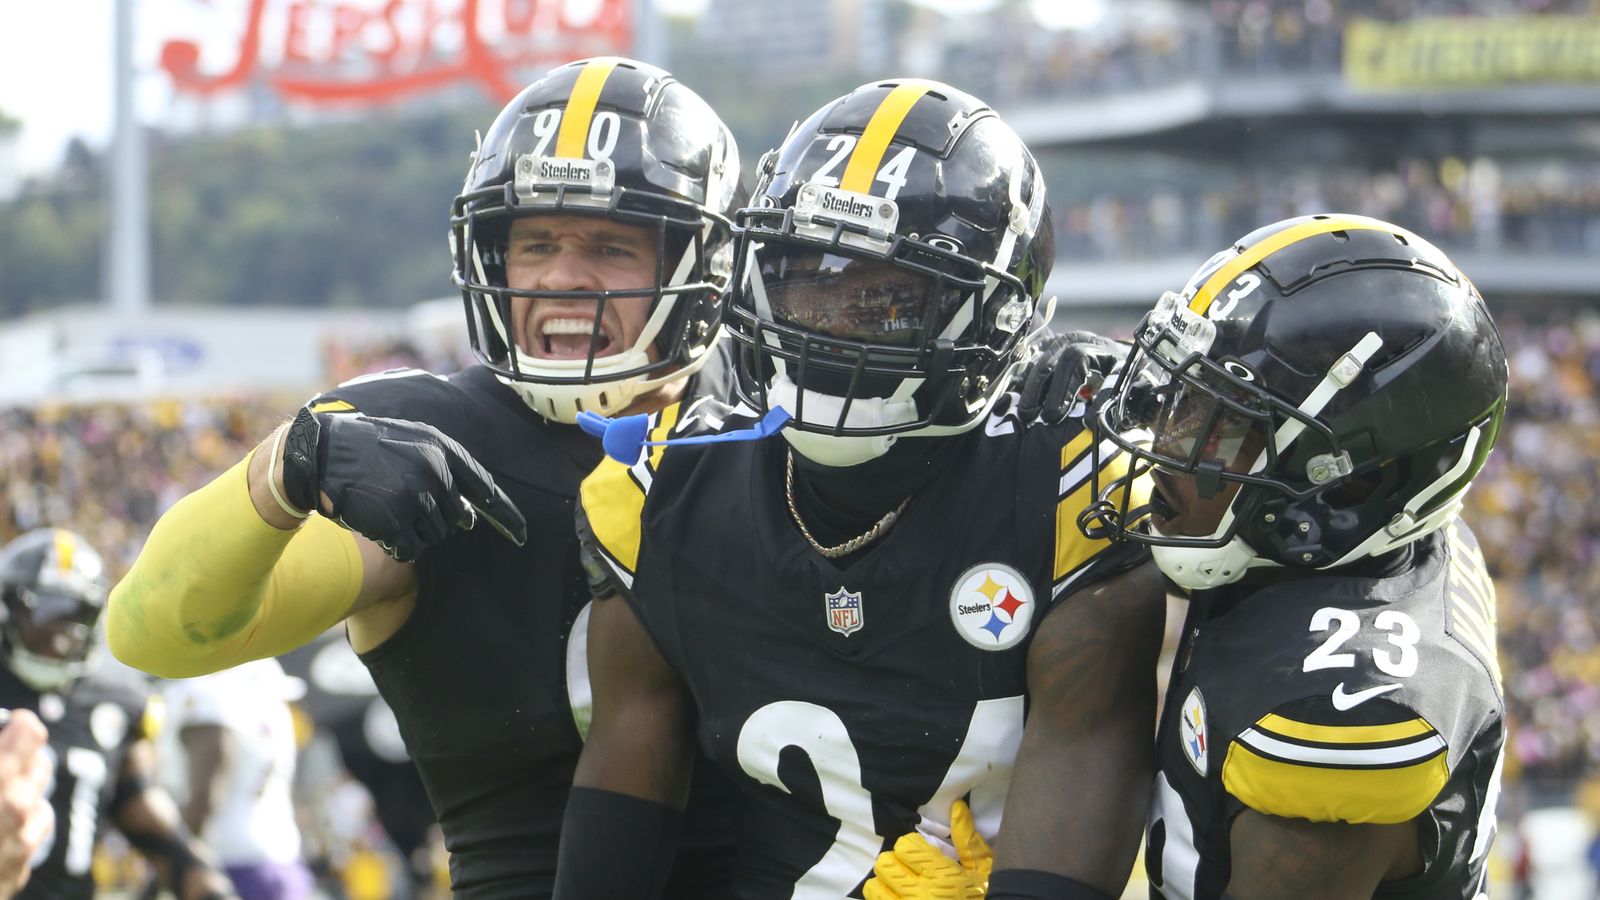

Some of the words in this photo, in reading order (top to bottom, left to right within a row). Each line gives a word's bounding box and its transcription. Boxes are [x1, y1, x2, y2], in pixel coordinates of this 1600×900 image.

[540, 161, 590, 180] Steelers
[822, 191, 873, 218] Steelers
[832, 609, 857, 628] NFL
[957, 603, 992, 615] Steelers
[1303, 607, 1421, 678] 23
